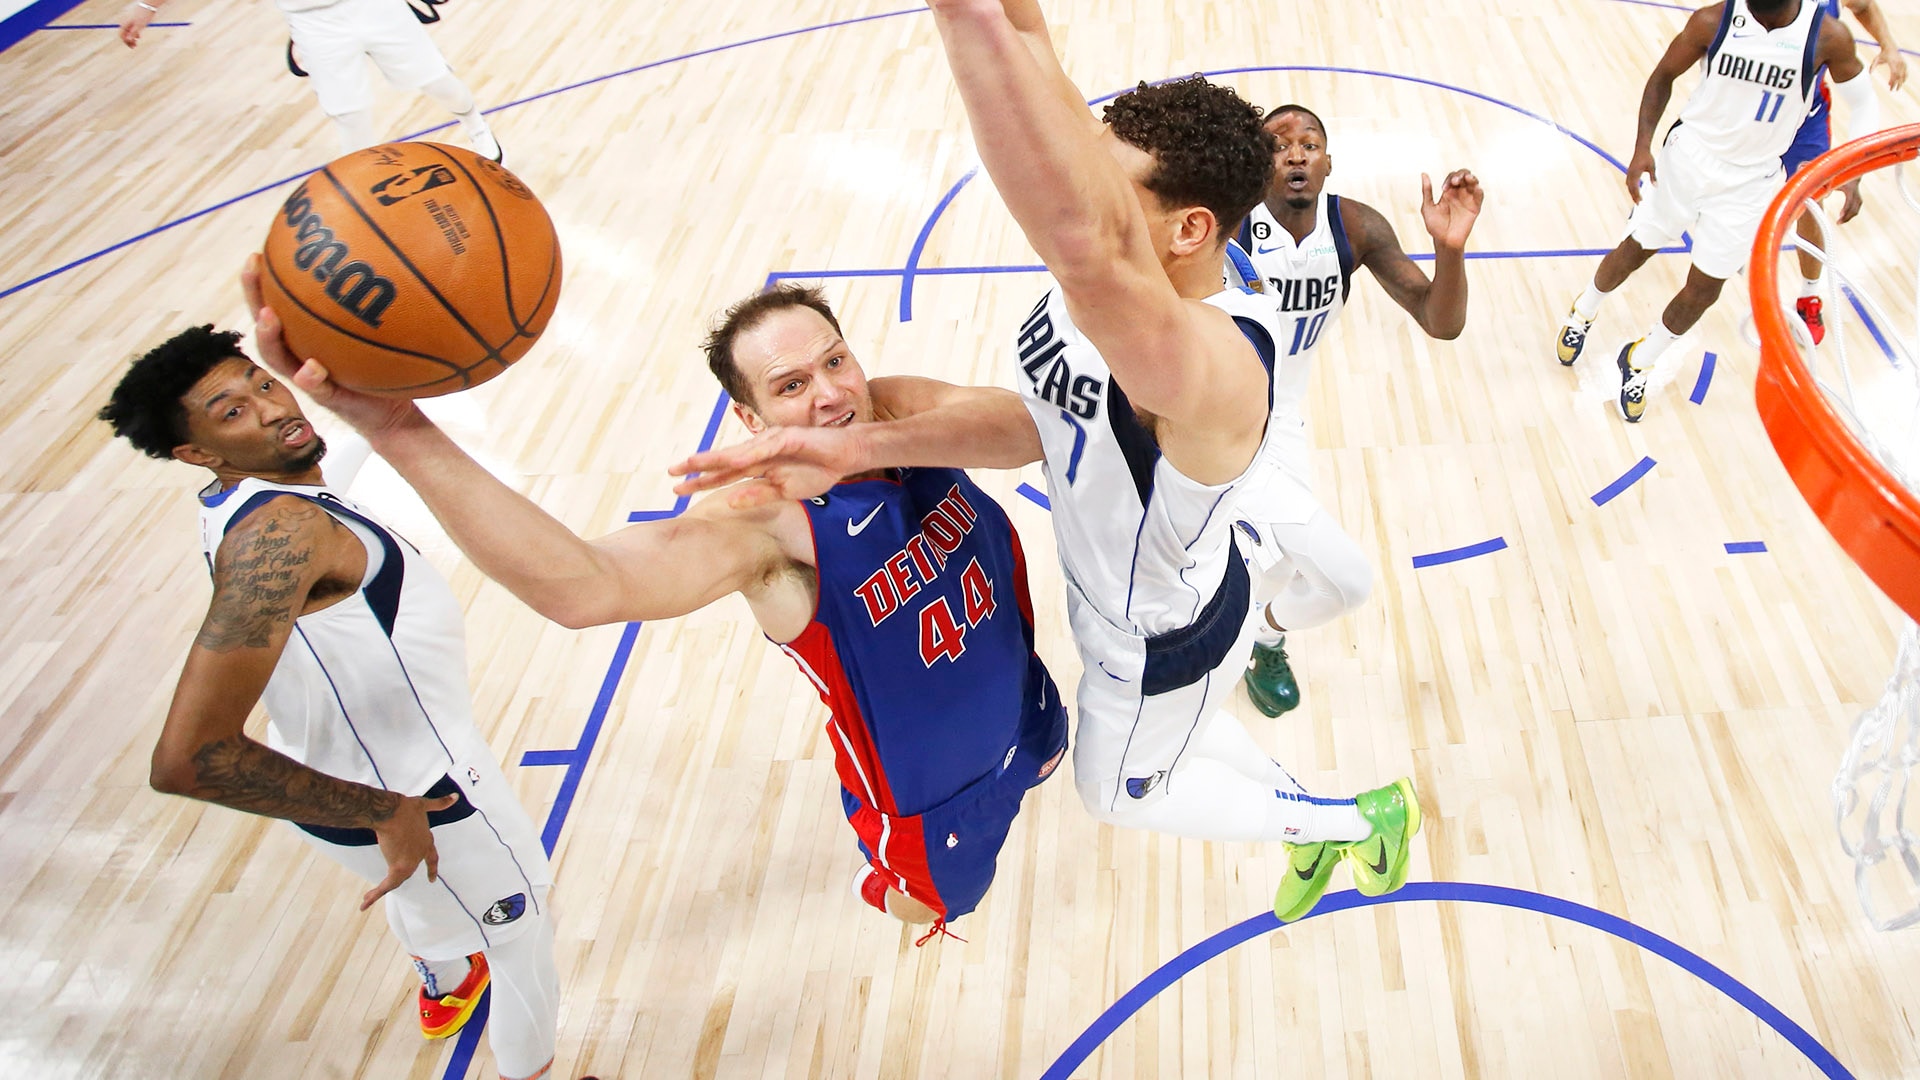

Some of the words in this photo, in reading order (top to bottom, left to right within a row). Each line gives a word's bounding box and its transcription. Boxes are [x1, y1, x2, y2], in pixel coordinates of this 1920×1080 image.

[1718, 53, 1797, 90] DALLAS
[1754, 90, 1786, 123] 11
[1254, 223, 1270, 239] 6
[284, 186, 397, 329] Wilson
[1018, 288, 1103, 420] DALAS
[1288, 310, 1330, 356] 10
[919, 556, 997, 669] 44
